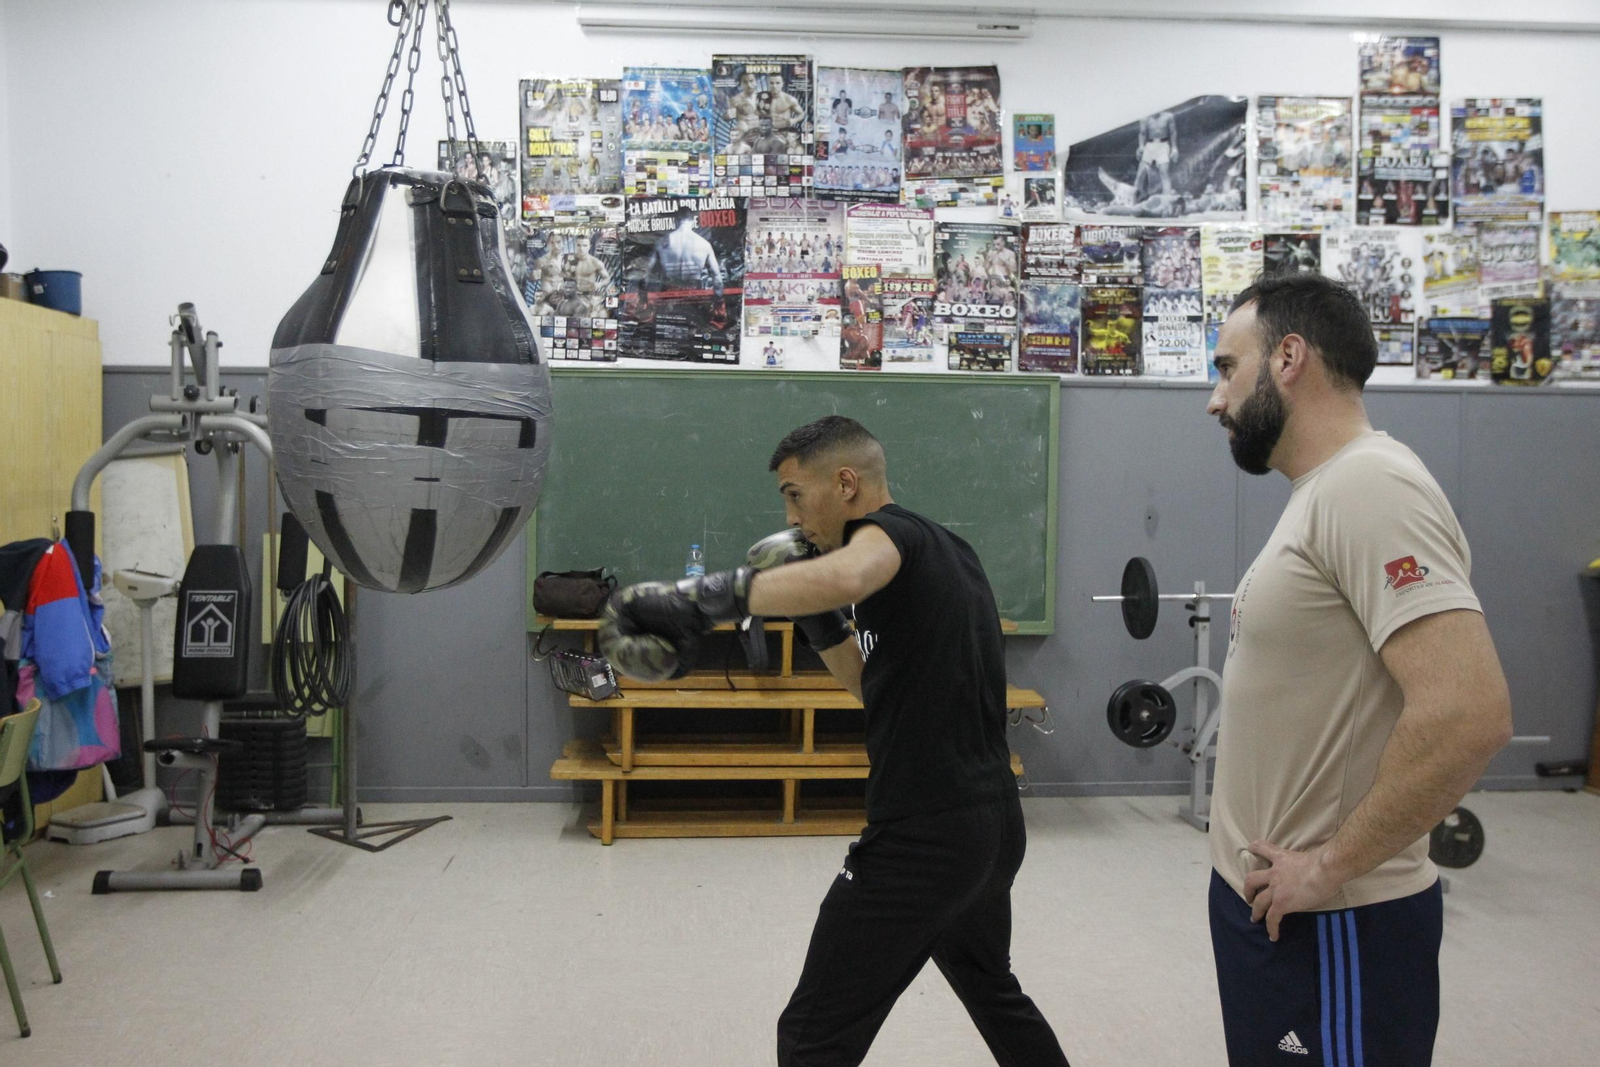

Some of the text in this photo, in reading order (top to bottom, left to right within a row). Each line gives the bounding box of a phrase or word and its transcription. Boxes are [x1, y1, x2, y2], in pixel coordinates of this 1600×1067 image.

[746, 65, 781, 73] BOXEO
[630, 202, 640, 216] LA
[641, 200, 678, 215] BATALLA
[680, 198, 697, 211] POR
[750, 197, 838, 210] BOXEO
[627, 219, 650, 233] NOCHE
[700, 210, 736, 228] BOXEO
[842, 266, 878, 280] BOXEO
[934, 303, 1017, 319] BOXEO
[1158, 339, 1187, 347] 22.00
[1278, 1043, 1308, 1055] adidas
